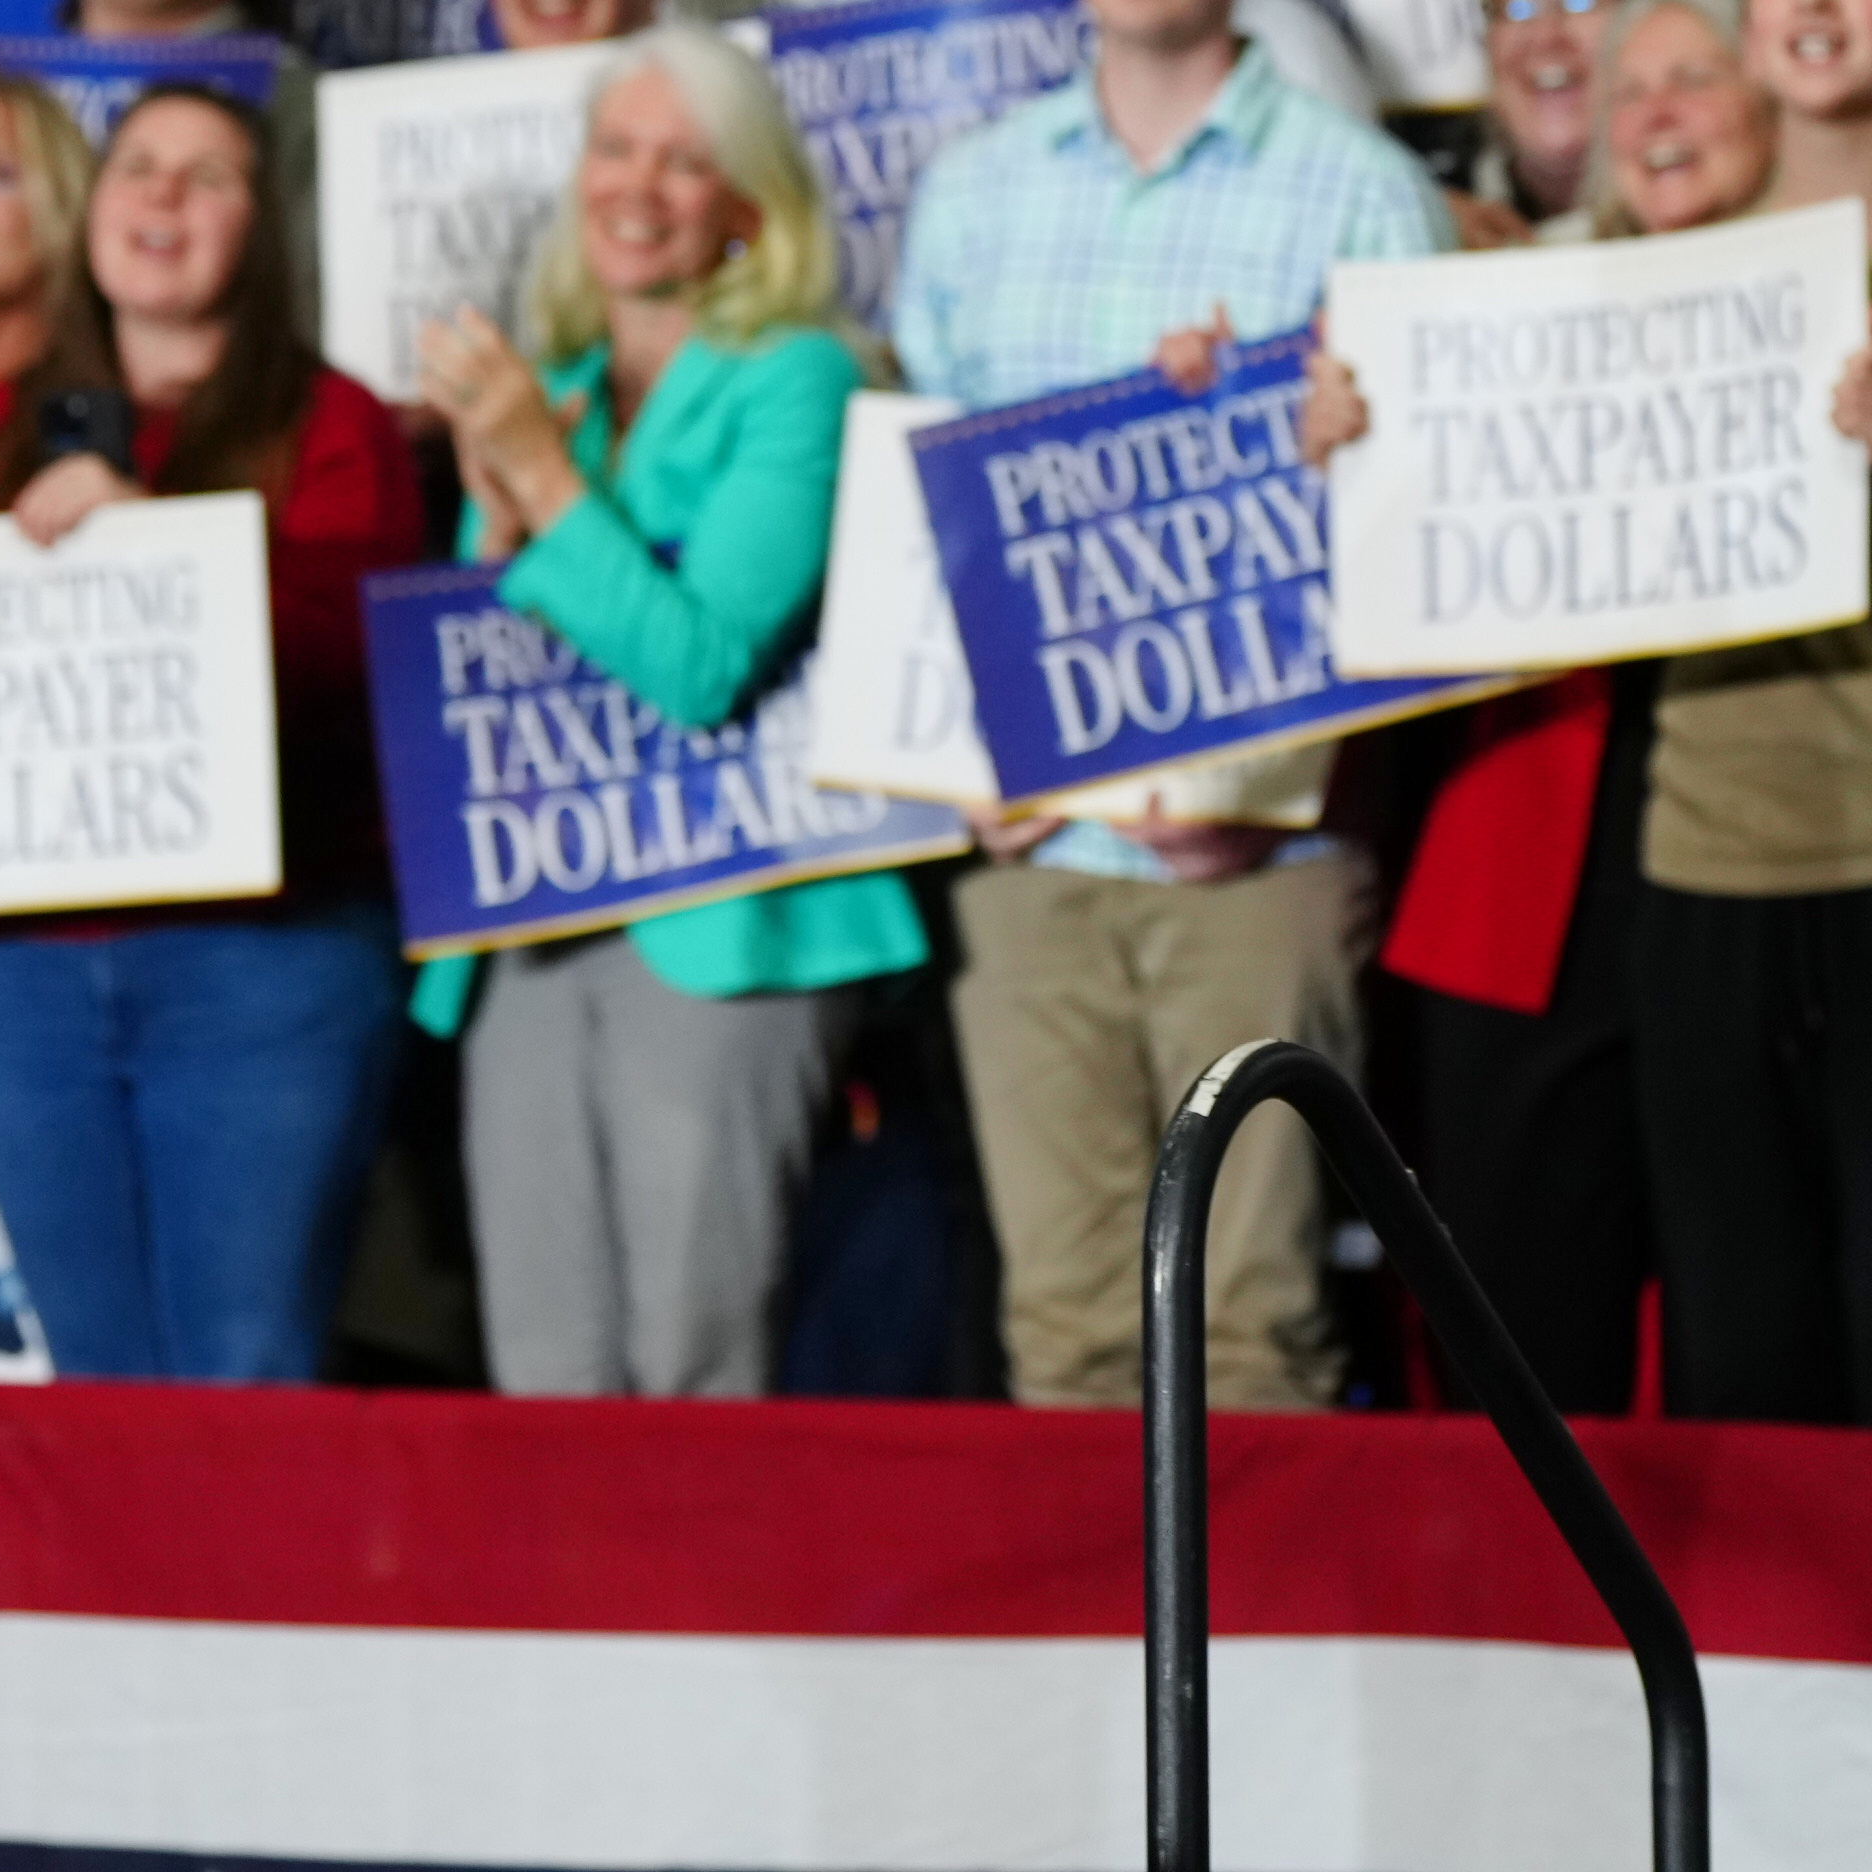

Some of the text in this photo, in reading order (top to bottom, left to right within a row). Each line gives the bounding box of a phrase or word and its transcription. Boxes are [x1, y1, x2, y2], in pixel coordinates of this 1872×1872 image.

[1410, 273, 1807, 399] PROTECTING
[1408, 366, 1808, 507] TAXPAYER
[1418, 478, 1809, 625] DOLLARS
